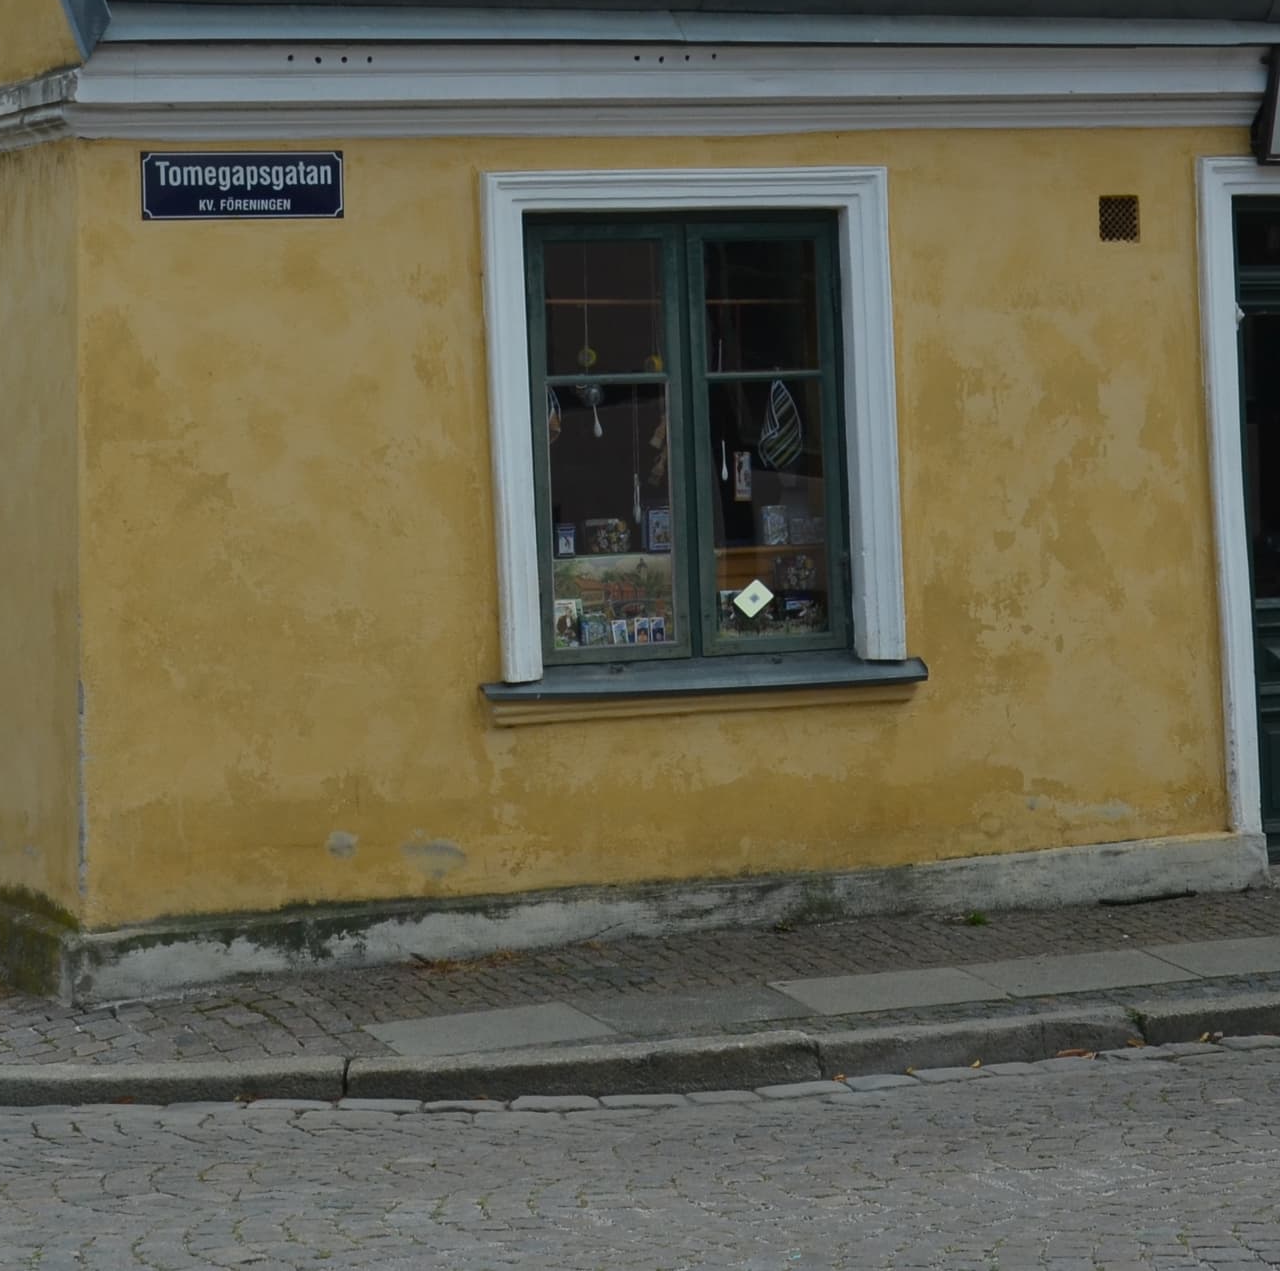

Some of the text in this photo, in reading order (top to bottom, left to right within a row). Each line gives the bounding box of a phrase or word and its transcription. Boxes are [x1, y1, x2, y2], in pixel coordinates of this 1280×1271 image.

[155, 160, 333, 191] Tomegapsgatan
[199, 196, 291, 211] KV. FÖRENINGEN
